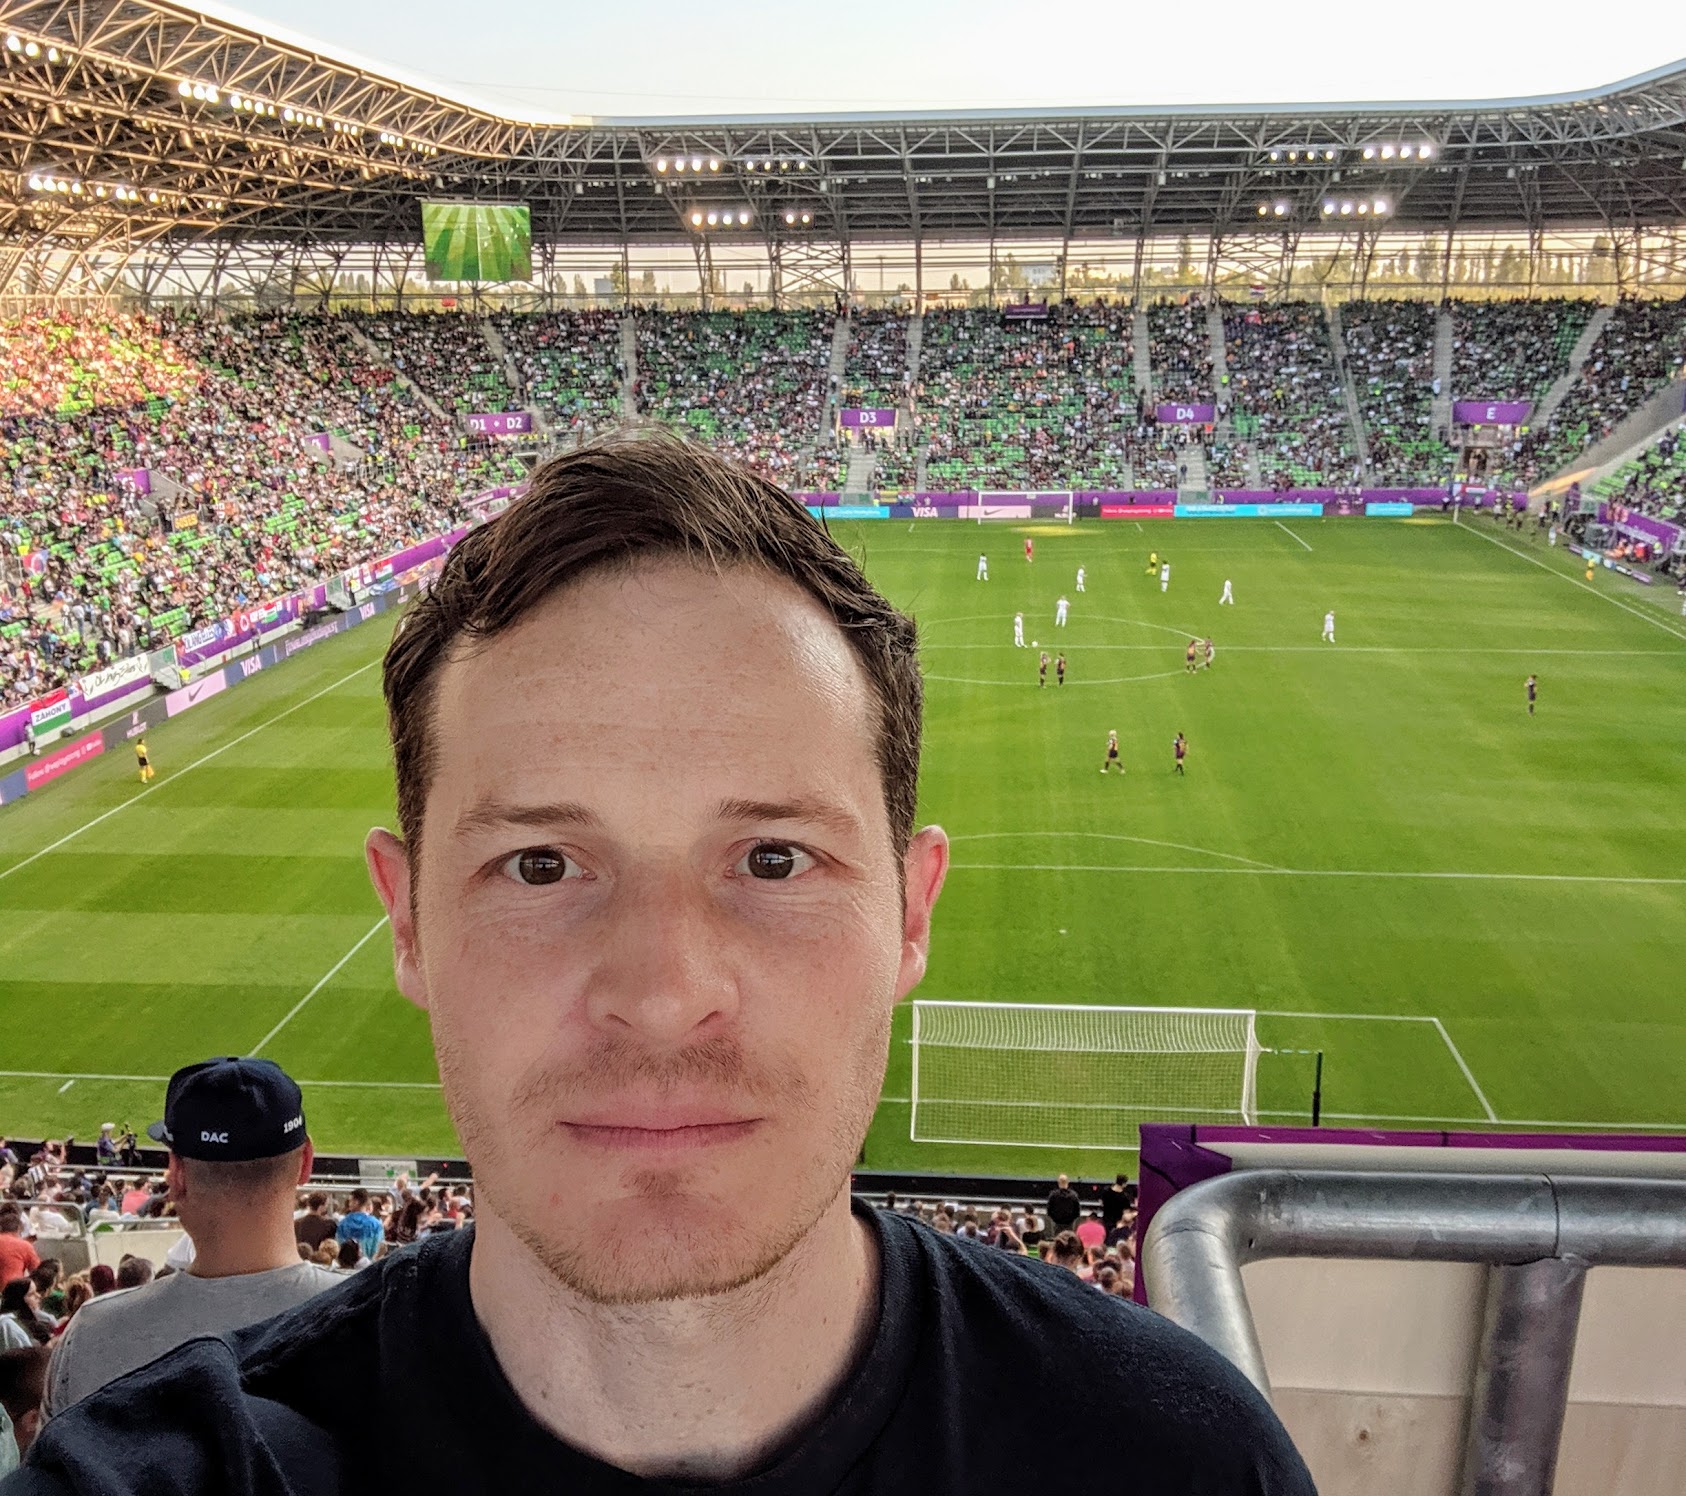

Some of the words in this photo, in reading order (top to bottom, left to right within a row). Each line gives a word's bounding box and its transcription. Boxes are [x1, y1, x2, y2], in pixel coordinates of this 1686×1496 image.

[860, 411, 877, 423] D3
[1176, 408, 1195, 420] D4
[1486, 407, 1496, 420] E
[506, 416, 523, 430] D2
[911, 507, 938, 518] VISA
[358, 602, 376, 621] VISA
[240, 654, 262, 677] VISA
[200, 1130, 229, 1144] DAC
